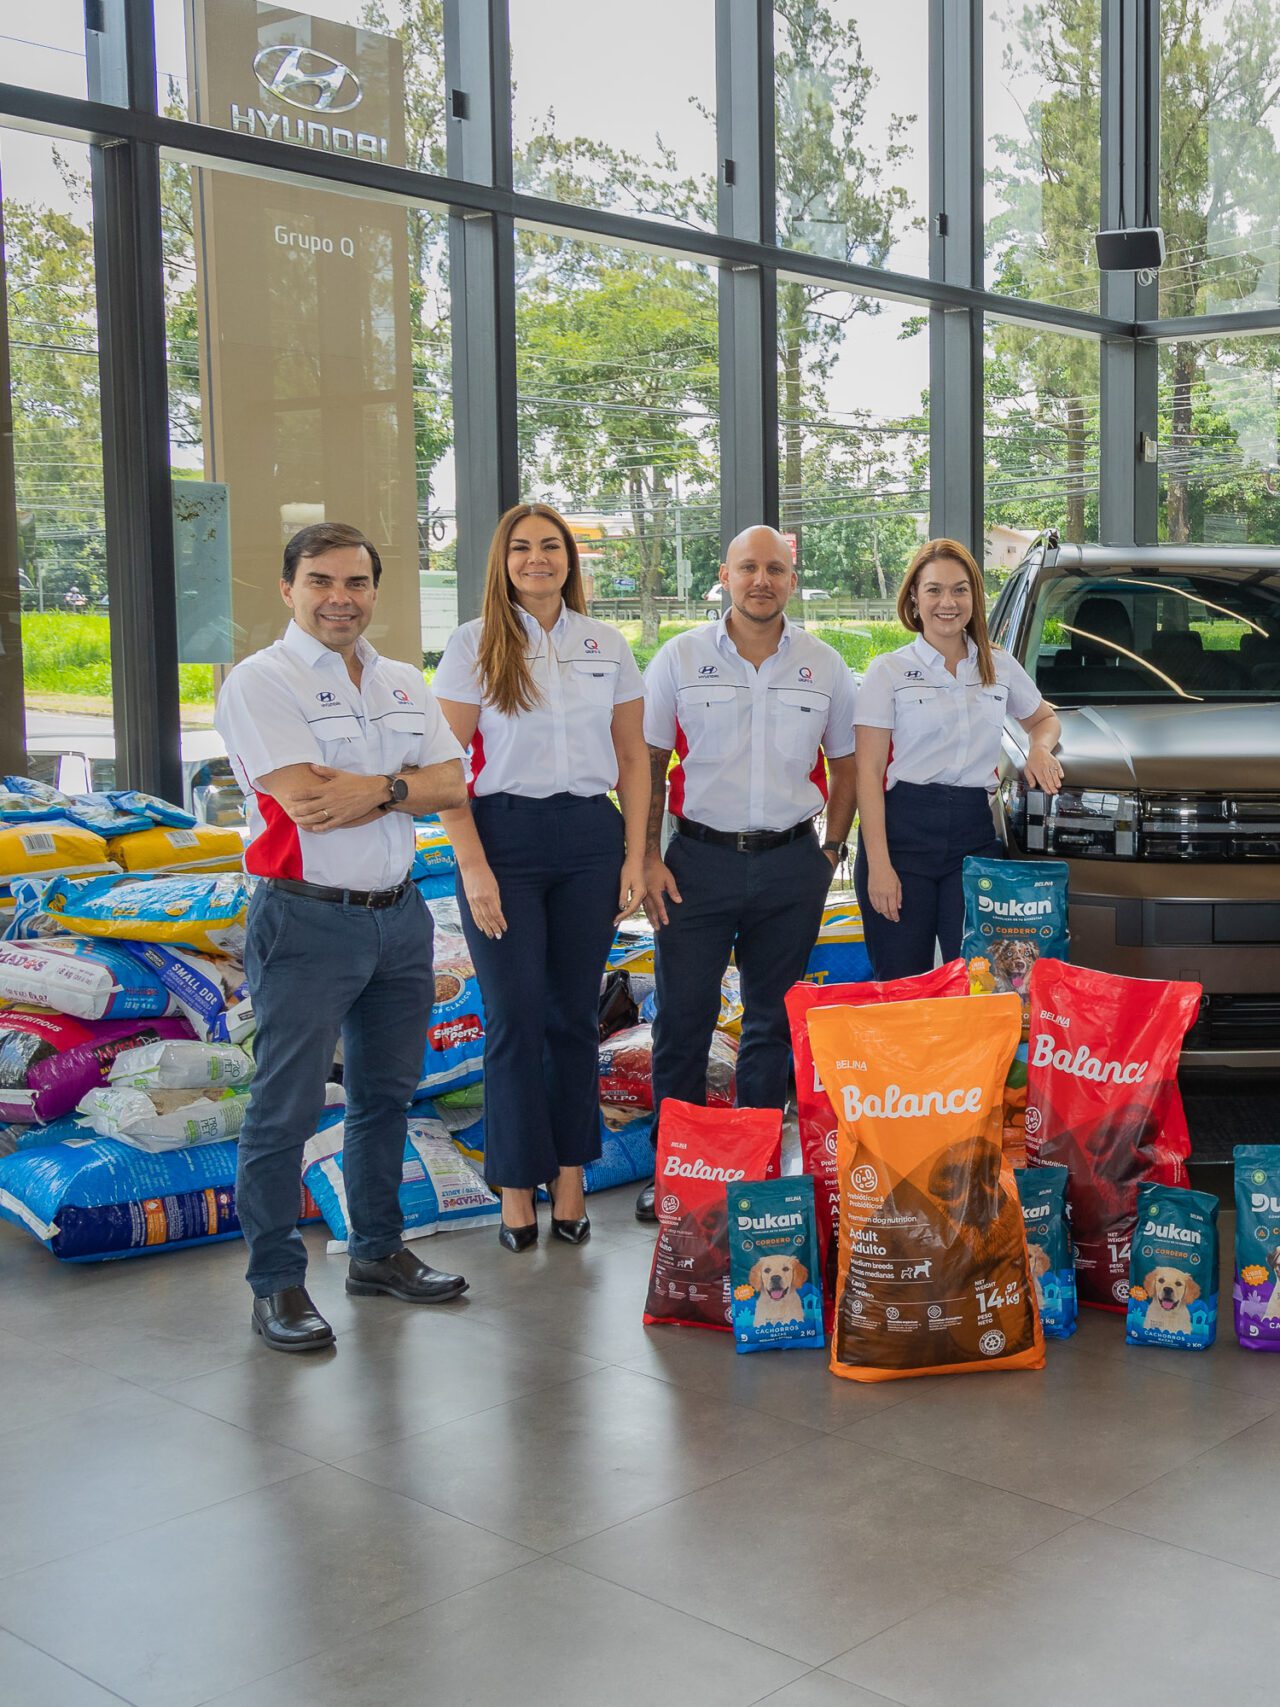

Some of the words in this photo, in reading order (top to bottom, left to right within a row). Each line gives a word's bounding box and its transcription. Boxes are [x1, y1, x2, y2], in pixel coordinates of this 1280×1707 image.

[231, 104, 388, 162] HYUNDAI
[274, 225, 333, 254] Grupo
[340, 238, 354, 258] Q
[978, 895, 1052, 917] Dukan
[171, 963, 201, 990] SMALL
[1040, 1010, 1071, 1028] BELINA
[433, 1023, 464, 1039] Super
[450, 1027, 479, 1041] Perro
[836, 1060, 867, 1071] BELINA
[840, 1084, 982, 1122] Balance
[664, 1156, 745, 1182] Balance
[849, 1200, 883, 1209] Probióticos
[1022, 1204, 1050, 1218] kan
[738, 1213, 803, 1230] Dukan
[887, 1216, 917, 1224] nutrition
[850, 1228, 878, 1242] Adult
[1144, 1221, 1201, 1243] Dukan
[756, 1237, 790, 1246] CORDERO
[850, 1241, 886, 1255] Adulto
[1107, 1243, 1131, 1262] 14
[1155, 1248, 1188, 1258] CORDERO
[851, 1258, 872, 1268] Medium
[872, 1262, 894, 1270] breeds
[865, 1270, 895, 1279] medianas
[975, 1281, 996, 1292] WEIGHT
[976, 1288, 1005, 1313] 14
[1006, 1293, 1020, 1305] kg
[977, 1318, 993, 1326] NETO
[756, 1325, 799, 1335] CACHORROS
[1144, 1330, 1185, 1341] CACHORROS
